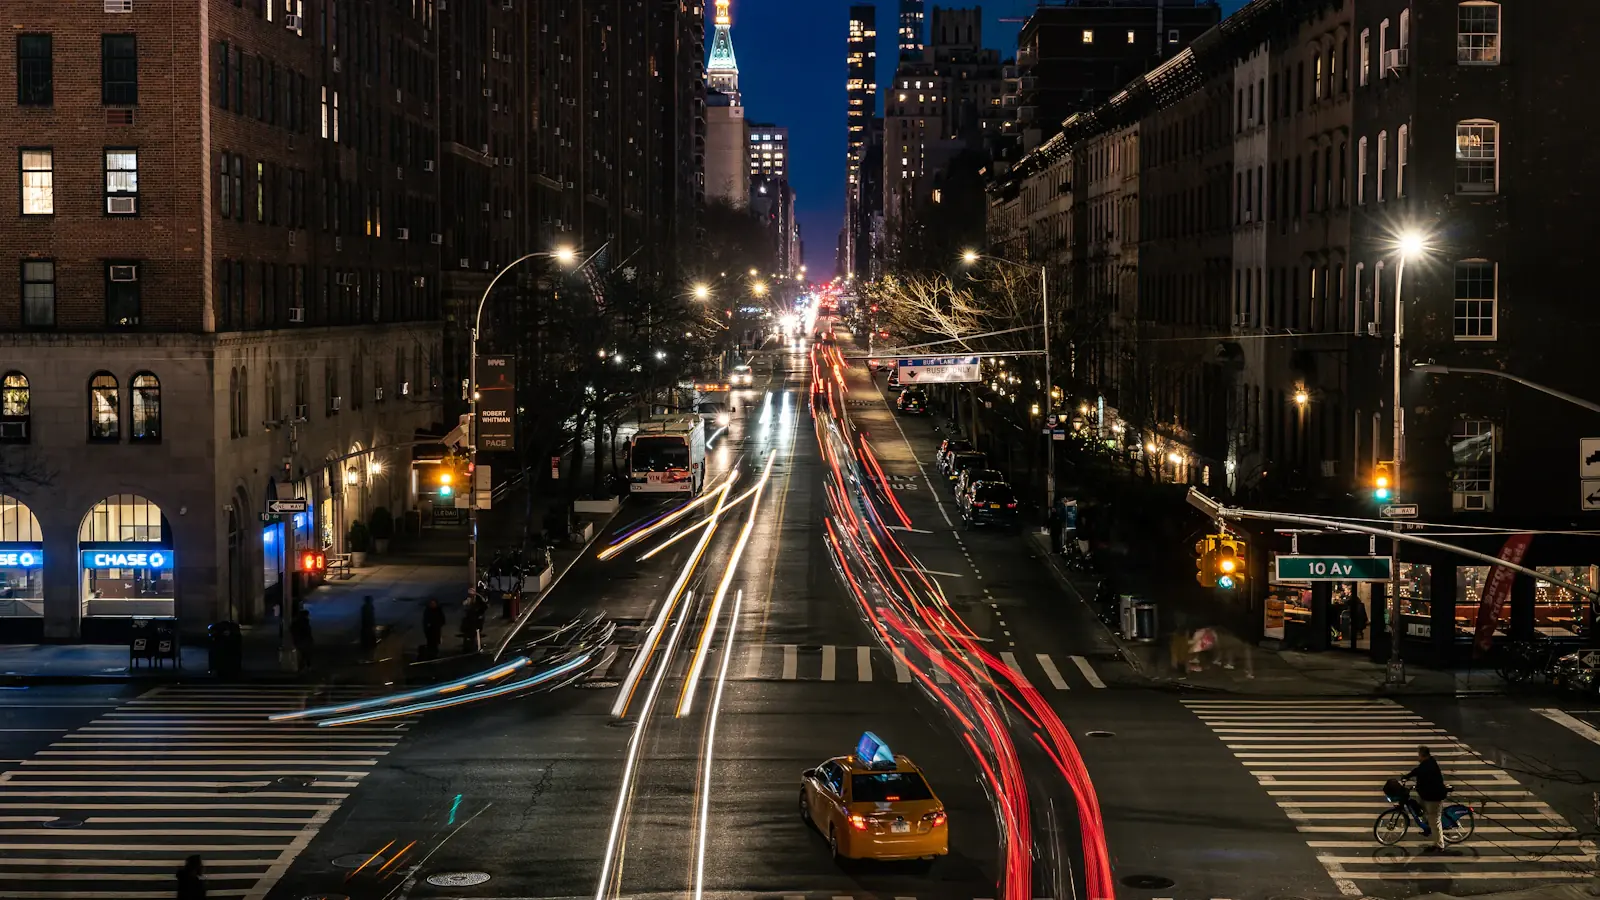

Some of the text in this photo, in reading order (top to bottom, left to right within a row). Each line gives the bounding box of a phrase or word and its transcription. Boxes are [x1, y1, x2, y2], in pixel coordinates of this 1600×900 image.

[261, 513, 270, 521] 10
[95, 554, 147, 566] CHASE
[1309, 562, 1353, 575] 10 Av
[1587, 655, 1600, 664] ON
